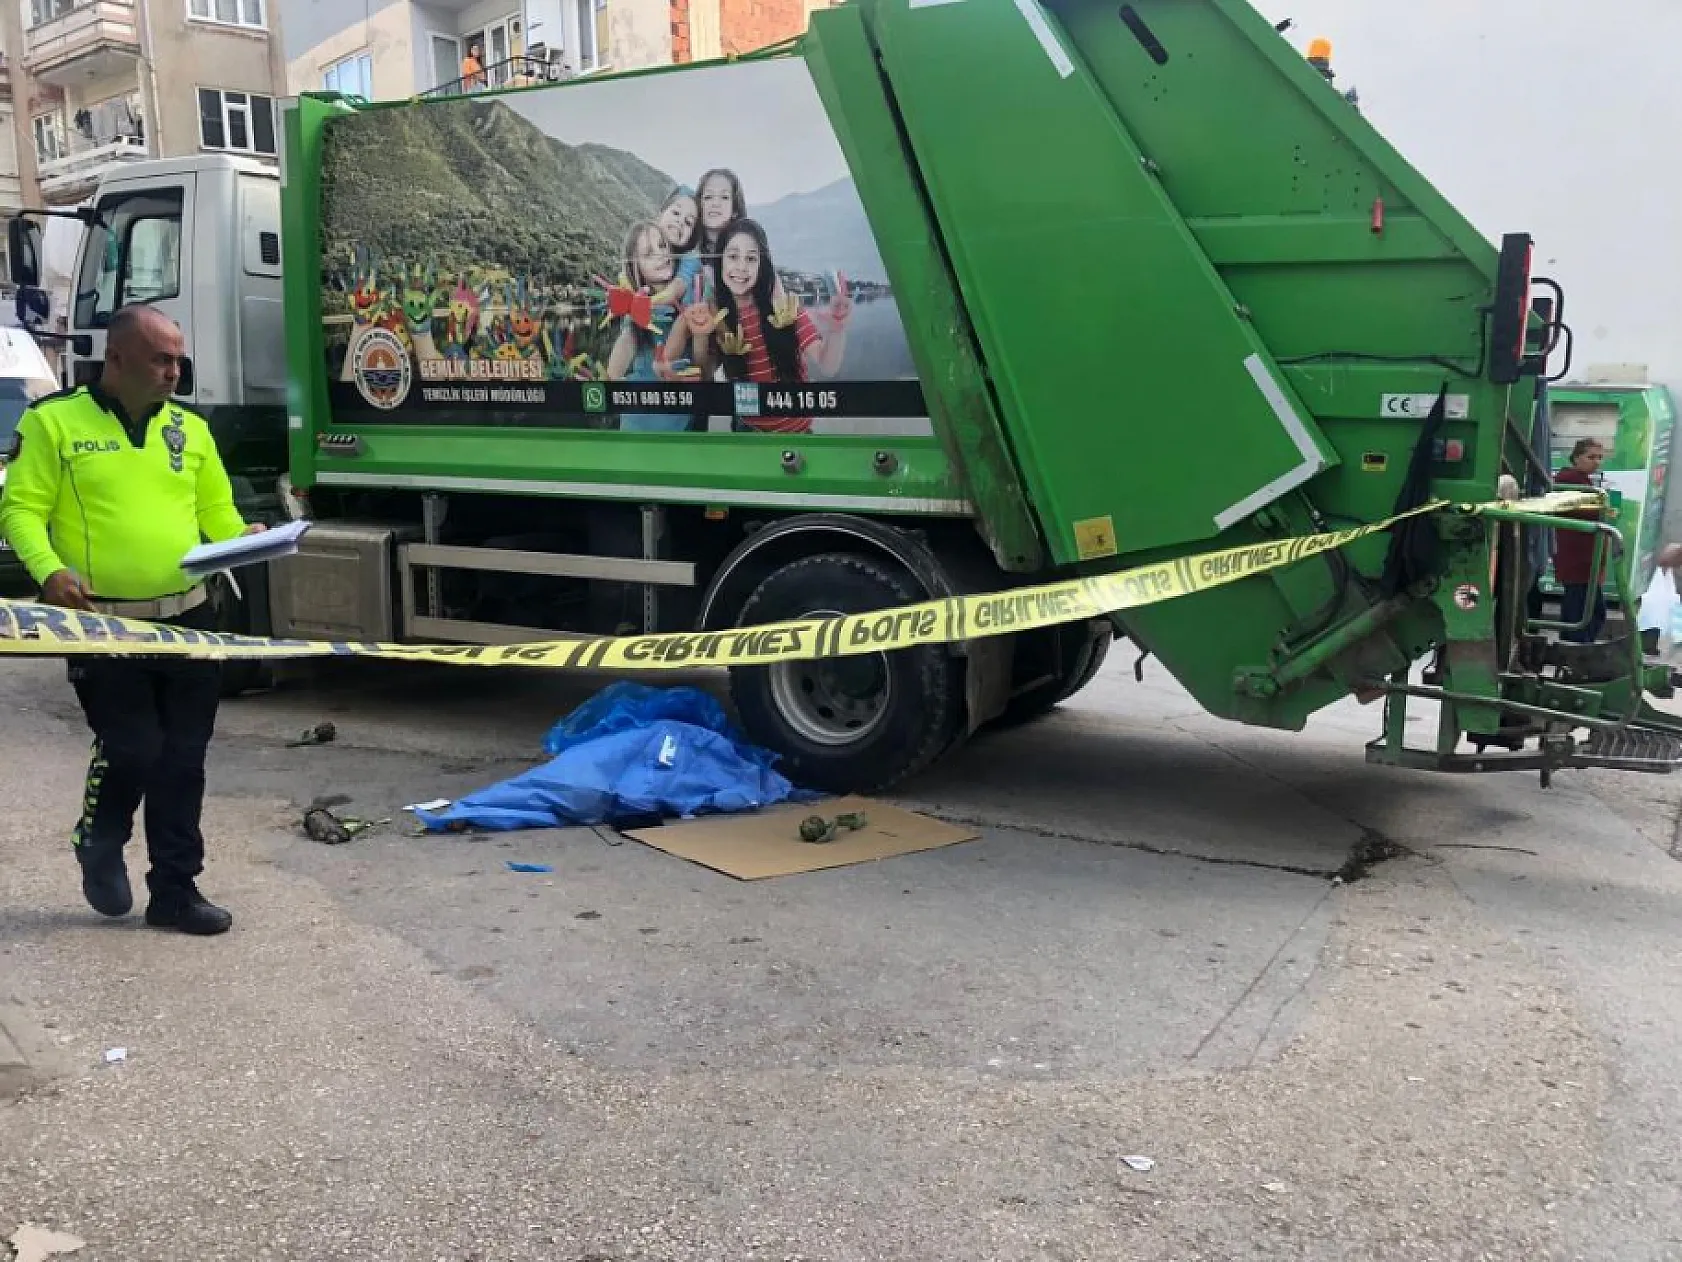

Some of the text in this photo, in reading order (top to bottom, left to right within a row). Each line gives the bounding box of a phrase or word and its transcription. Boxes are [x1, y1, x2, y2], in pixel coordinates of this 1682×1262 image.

[421, 356, 542, 378] GEMLİK BELEDİYESİ
[766, 391, 793, 409] 444
[797, 391, 814, 409] 16
[818, 390, 837, 409] 05
